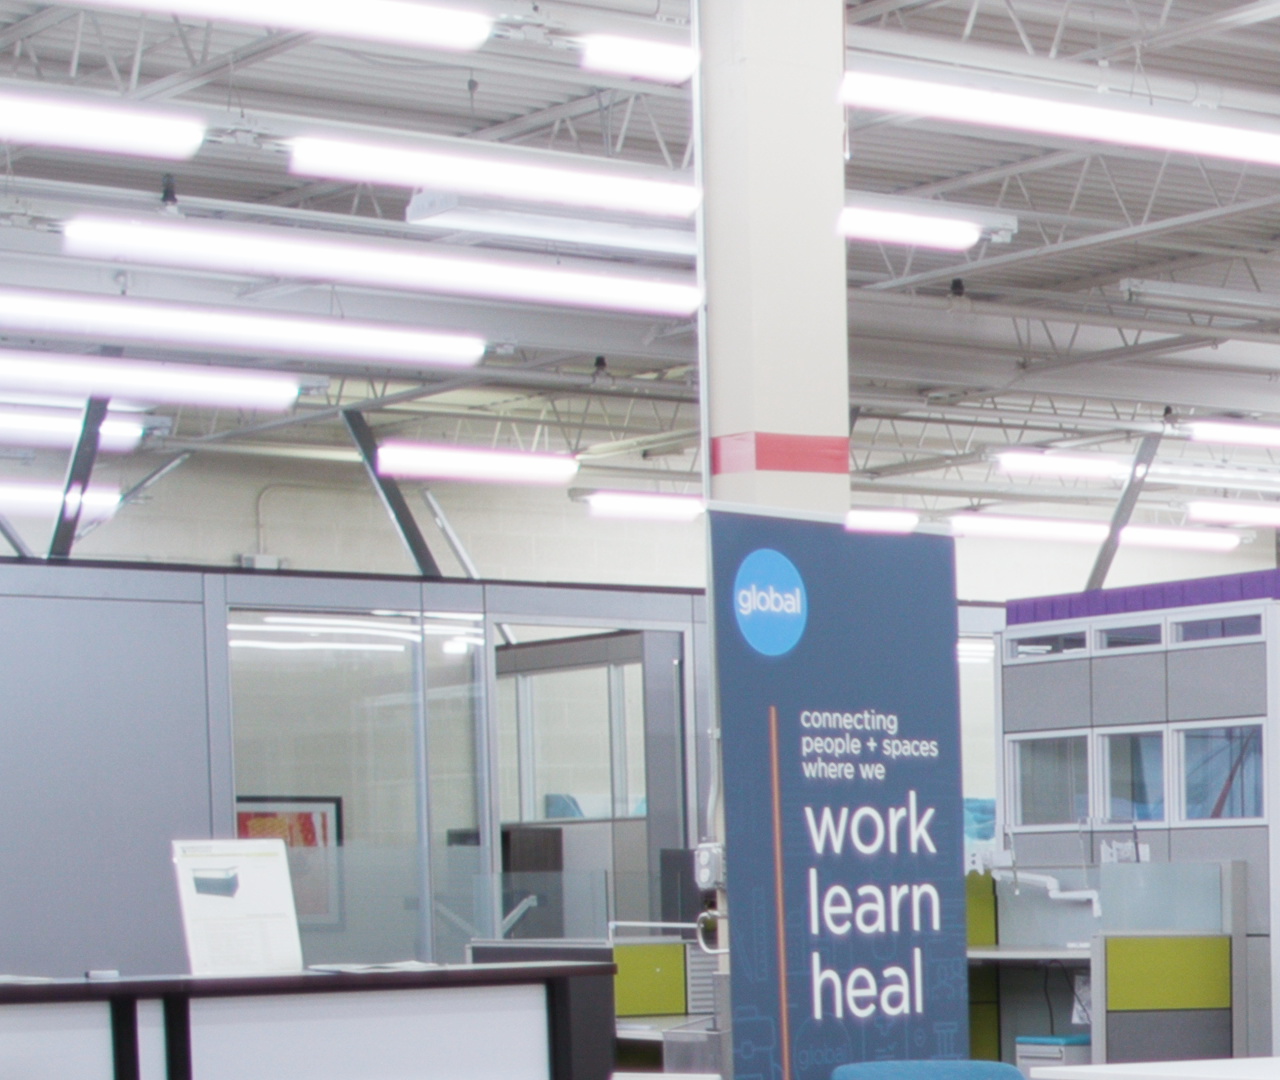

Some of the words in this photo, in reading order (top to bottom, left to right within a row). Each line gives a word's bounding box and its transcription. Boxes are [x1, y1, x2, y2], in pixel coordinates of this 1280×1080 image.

[737, 584, 801, 615] global
[800, 709, 898, 735] connecting
[801, 733, 862, 757] people
[866, 737, 877, 752] +
[882, 738, 939, 759] spaces
[802, 757, 854, 779] where
[858, 763, 886, 780] we
[804, 790, 937, 855] work
[808, 867, 940, 935] learn
[812, 947, 923, 1020] heal
